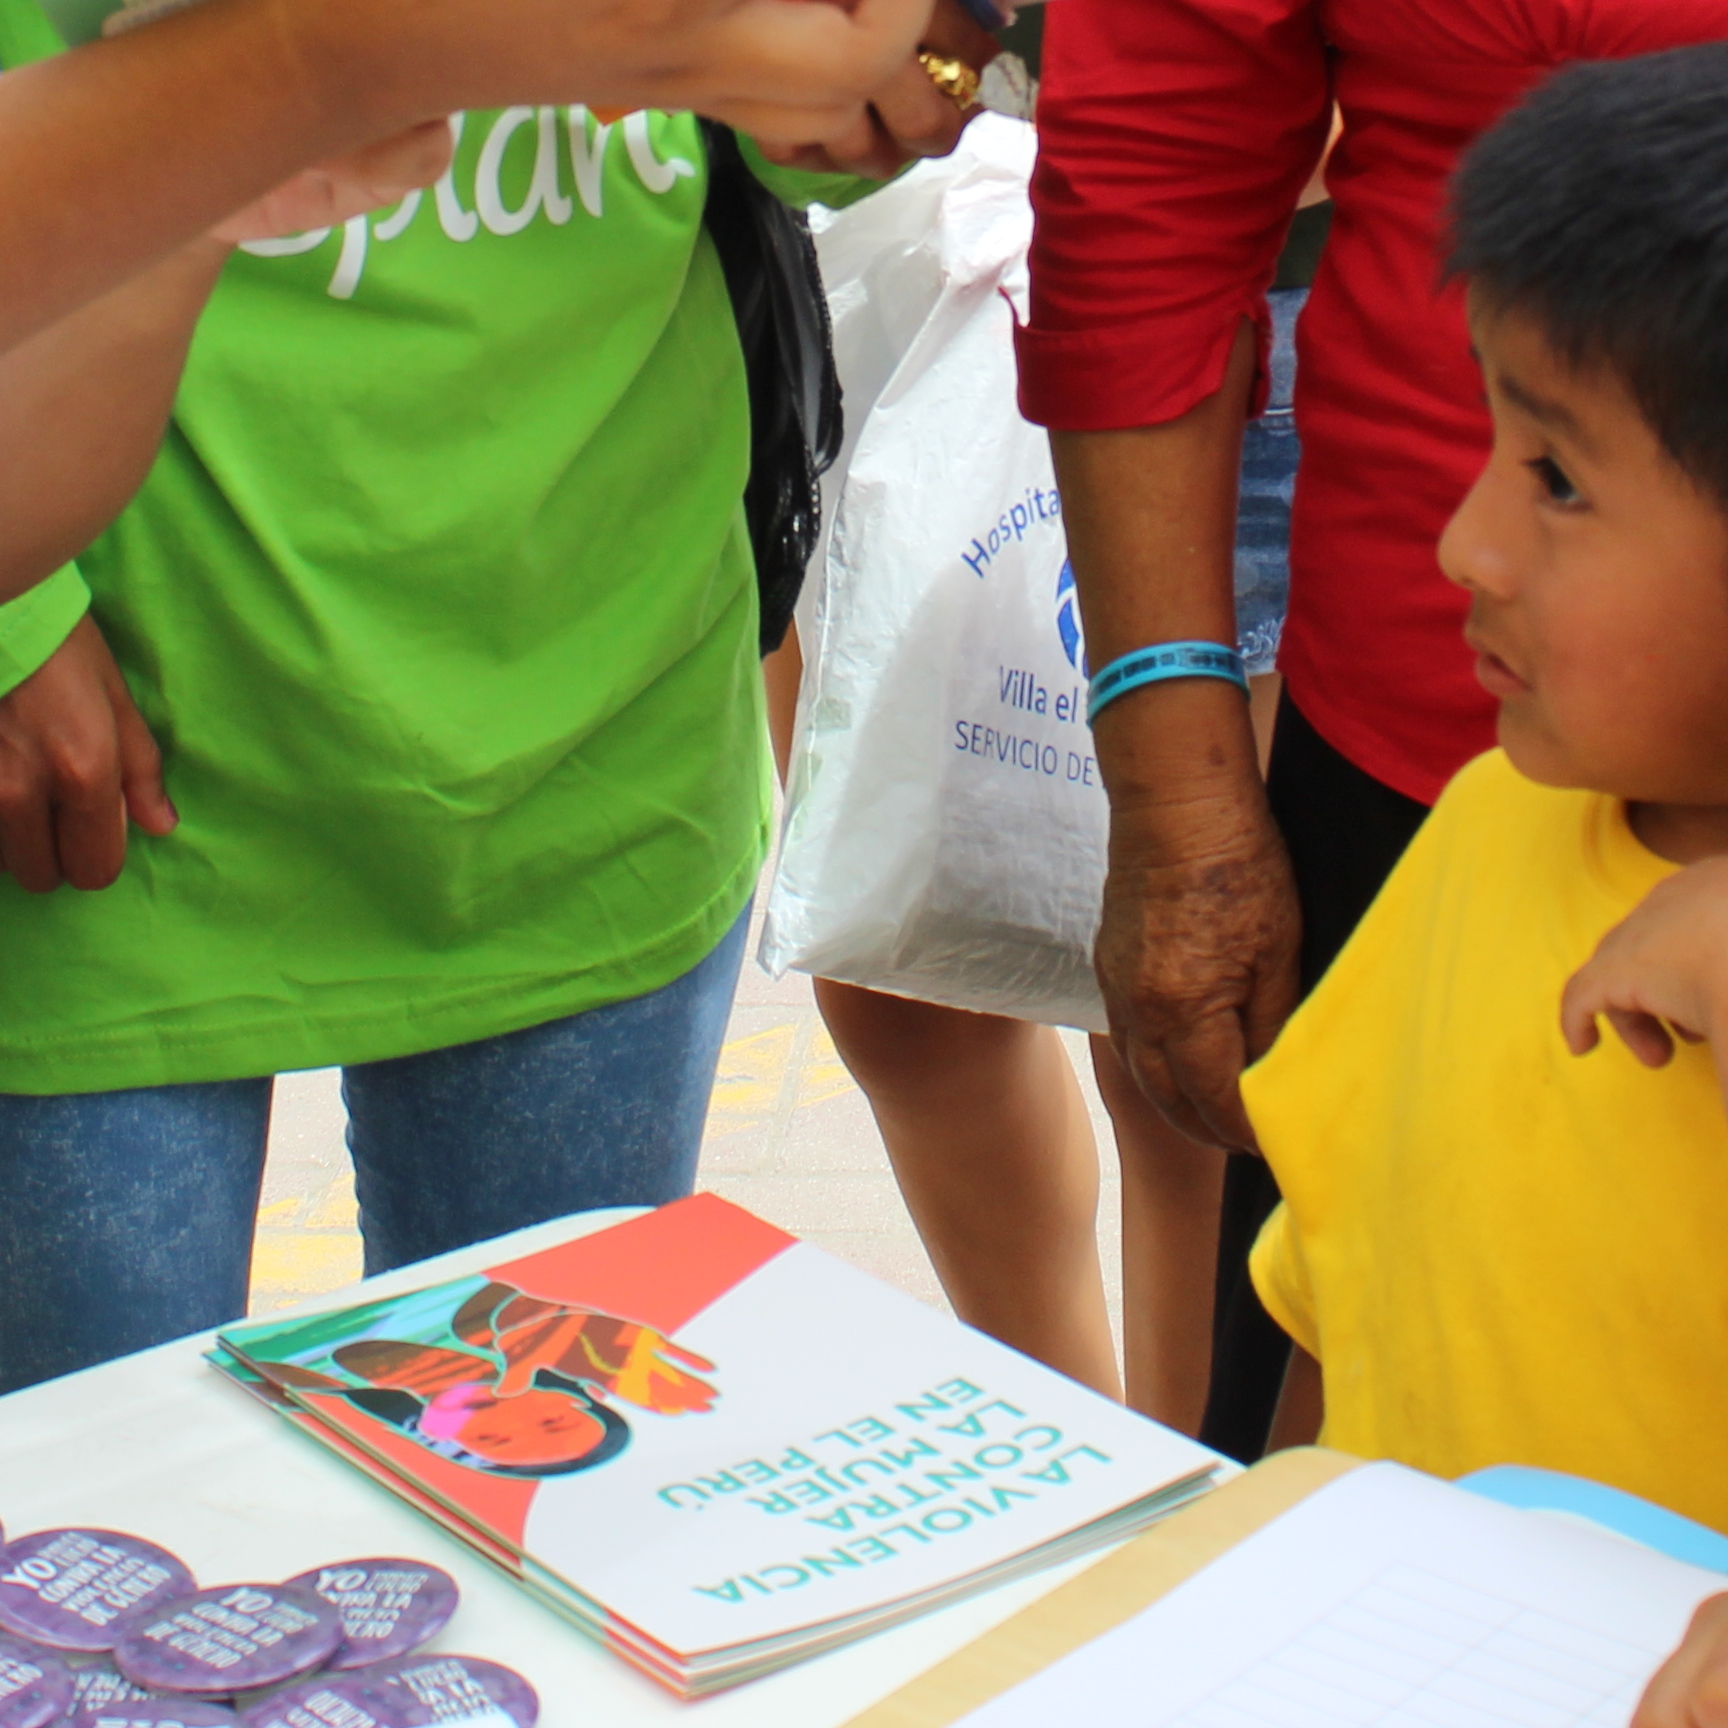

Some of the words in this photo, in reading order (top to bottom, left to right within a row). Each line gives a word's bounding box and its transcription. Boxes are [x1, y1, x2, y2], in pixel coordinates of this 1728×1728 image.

[960, 487, 1061, 579] Hospita
[999, 664, 1048, 716] Villa
[1054, 685, 1079, 724] el
[953, 719, 1059, 776] SERVICIO
[1066, 751, 1096, 787] DE
[892, 1375, 987, 1424] EN
[935, 1396, 1029, 1440] LA
[809, 1414, 899, 1450] EL
[655, 1444, 820, 1512] PERÚ
[744, 1436, 944, 1516] MUJER
[801, 1423, 1066, 1534] CONTRA
[1019, 1442, 1115, 1488] LA
[690, 1483, 1040, 1605] VIOLENCIA
[0, 1556, 58, 1591] YO
[219, 1586, 274, 1613] YO
[314, 1568, 368, 1593] YO
